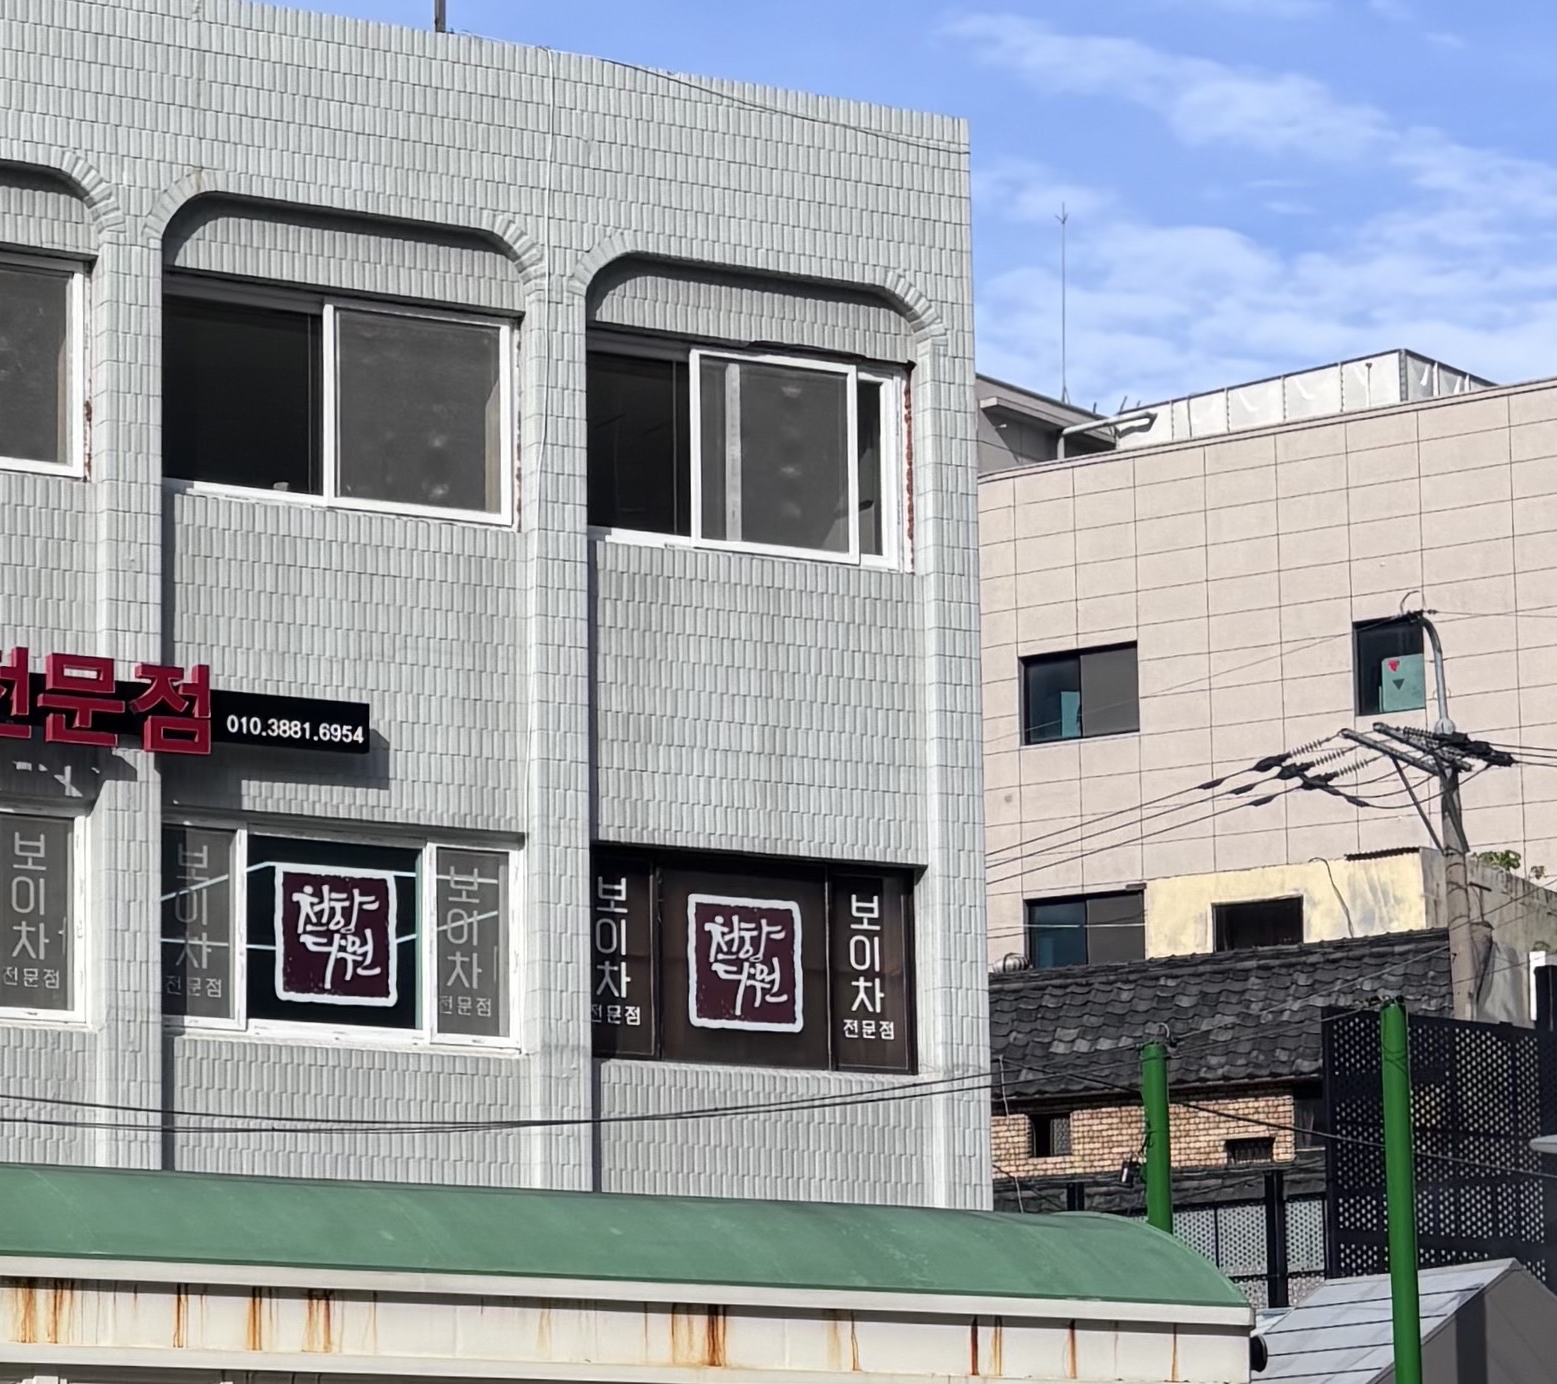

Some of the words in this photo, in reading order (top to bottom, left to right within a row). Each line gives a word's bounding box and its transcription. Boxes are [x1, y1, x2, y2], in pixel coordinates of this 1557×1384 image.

[227, 714, 364, 744] 010.3881.6954
[11, 831, 49, 961] 보이차
[175, 843, 212, 969] 보이차
[446, 865, 482, 990] 보이차
[595, 876, 632, 999] 보이차
[849, 893, 885, 1014] 보이차
[3, 966, 60, 989] 전문점
[843, 1019, 895, 1041] 전문점
